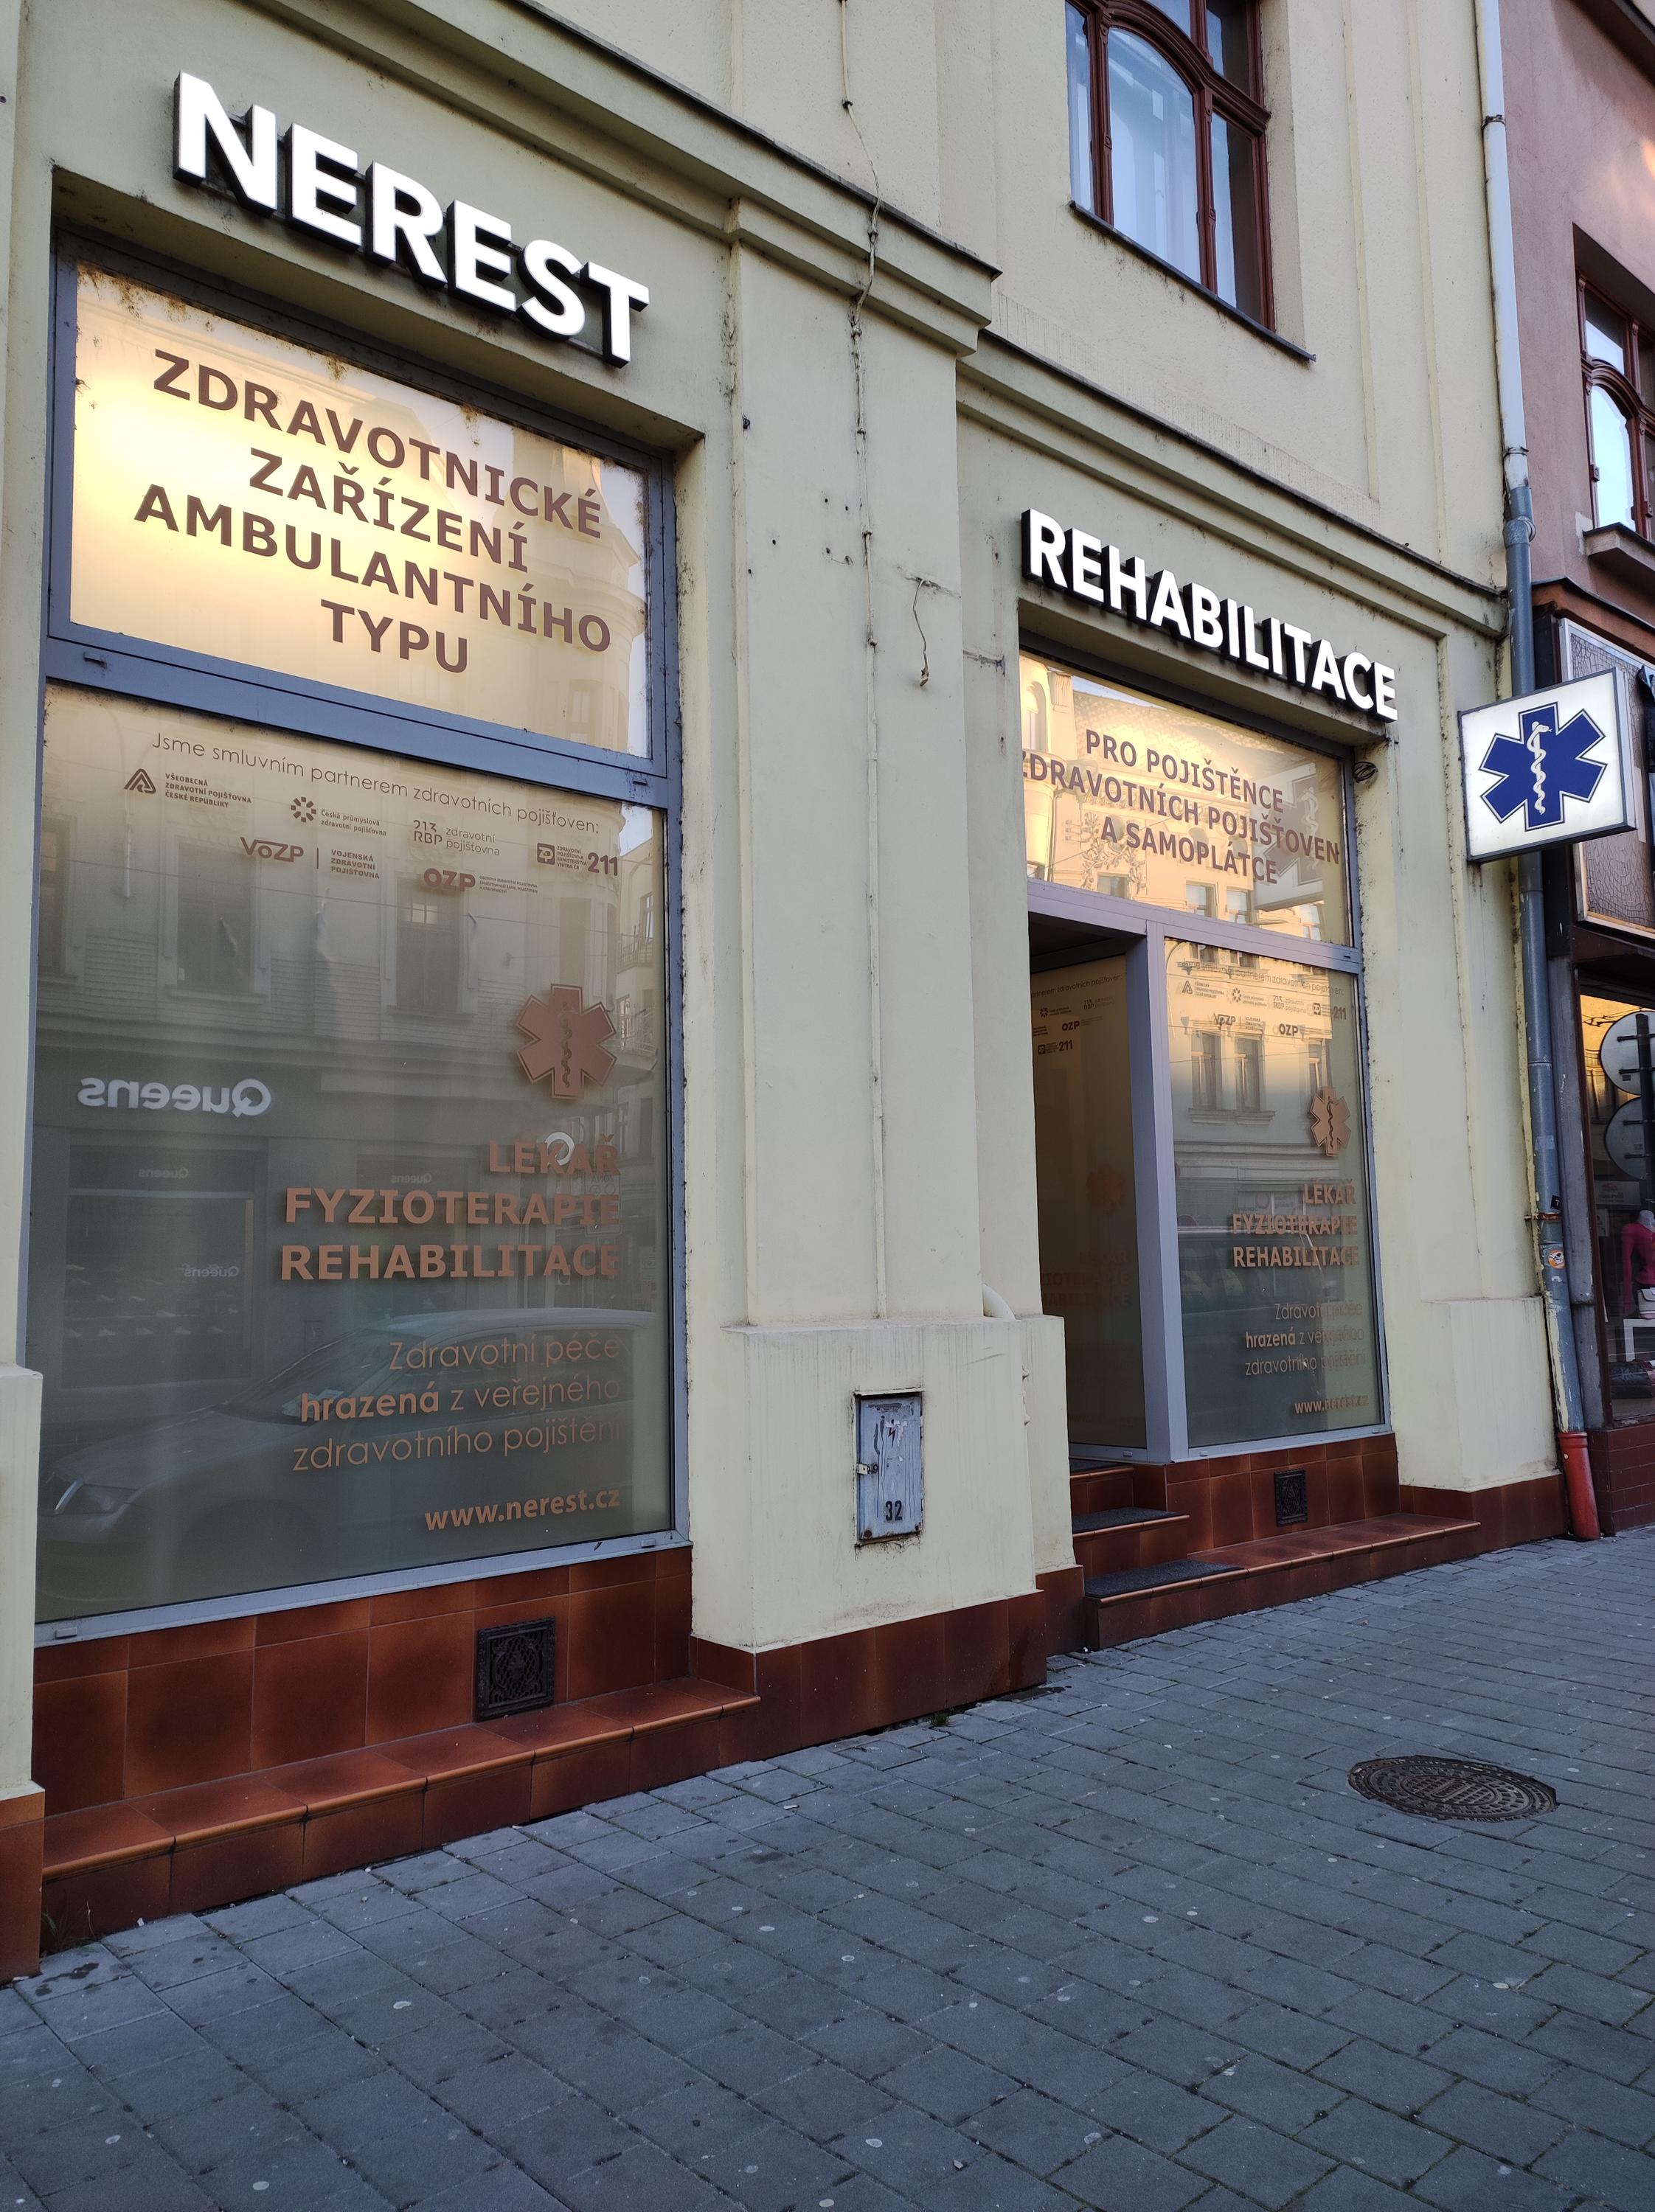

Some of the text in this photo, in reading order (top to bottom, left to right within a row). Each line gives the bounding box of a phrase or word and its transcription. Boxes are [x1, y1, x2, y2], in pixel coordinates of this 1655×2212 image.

[176, 71, 650, 369] NEREST
[153, 349, 602, 540] ZDRAVOTNICKÉ
[249, 448, 528, 573] ZAŘÍZENÍ
[133, 484, 611, 653] AMBULANTNÍHO
[1024, 509, 1398, 721] REHABILITACE
[321, 600, 468, 674] TYPU
[152, 732, 599, 834] Jsme smluvním partnerem zdravotních pojišťoven:
[165, 772, 208, 787] VŠEOBECNÁ
[165, 782, 207, 796] ZDRAVOTNÍ
[1086, 728, 1283, 813] PRO POJIŠTĚNCE
[414, 830, 443, 845] RBP
[445, 827, 496, 844] zdravotní
[1101, 815, 1277, 884] A SAMOPLÁTCE
[1209, 805, 1339, 865] POJIŠŤOVEN
[423, 868, 476, 892] OZP
[587, 852, 618, 876] 211
[1061, 1020, 1080, 1032] OZP
[1278, 1023, 1299, 1037] OZP
[1333, 1005, 1347, 1020] 211
[1058, 1040, 1073, 1052] 211
[285, 1187, 621, 1228] FYZIOTERAPIE
[280, 1243, 621, 1281] REHABILITACE
[389, 1332, 620, 1370] Zdravotní péče
[1246, 1327, 1296, 1348] hrazená
[301, 1374, 620, 1422] hrazená z veřejného
[293, 1425, 493, 1471] zdravotního
[425, 1488, 621, 1531] www.nerest.cz
[885, 1500, 903, 1521] 32
